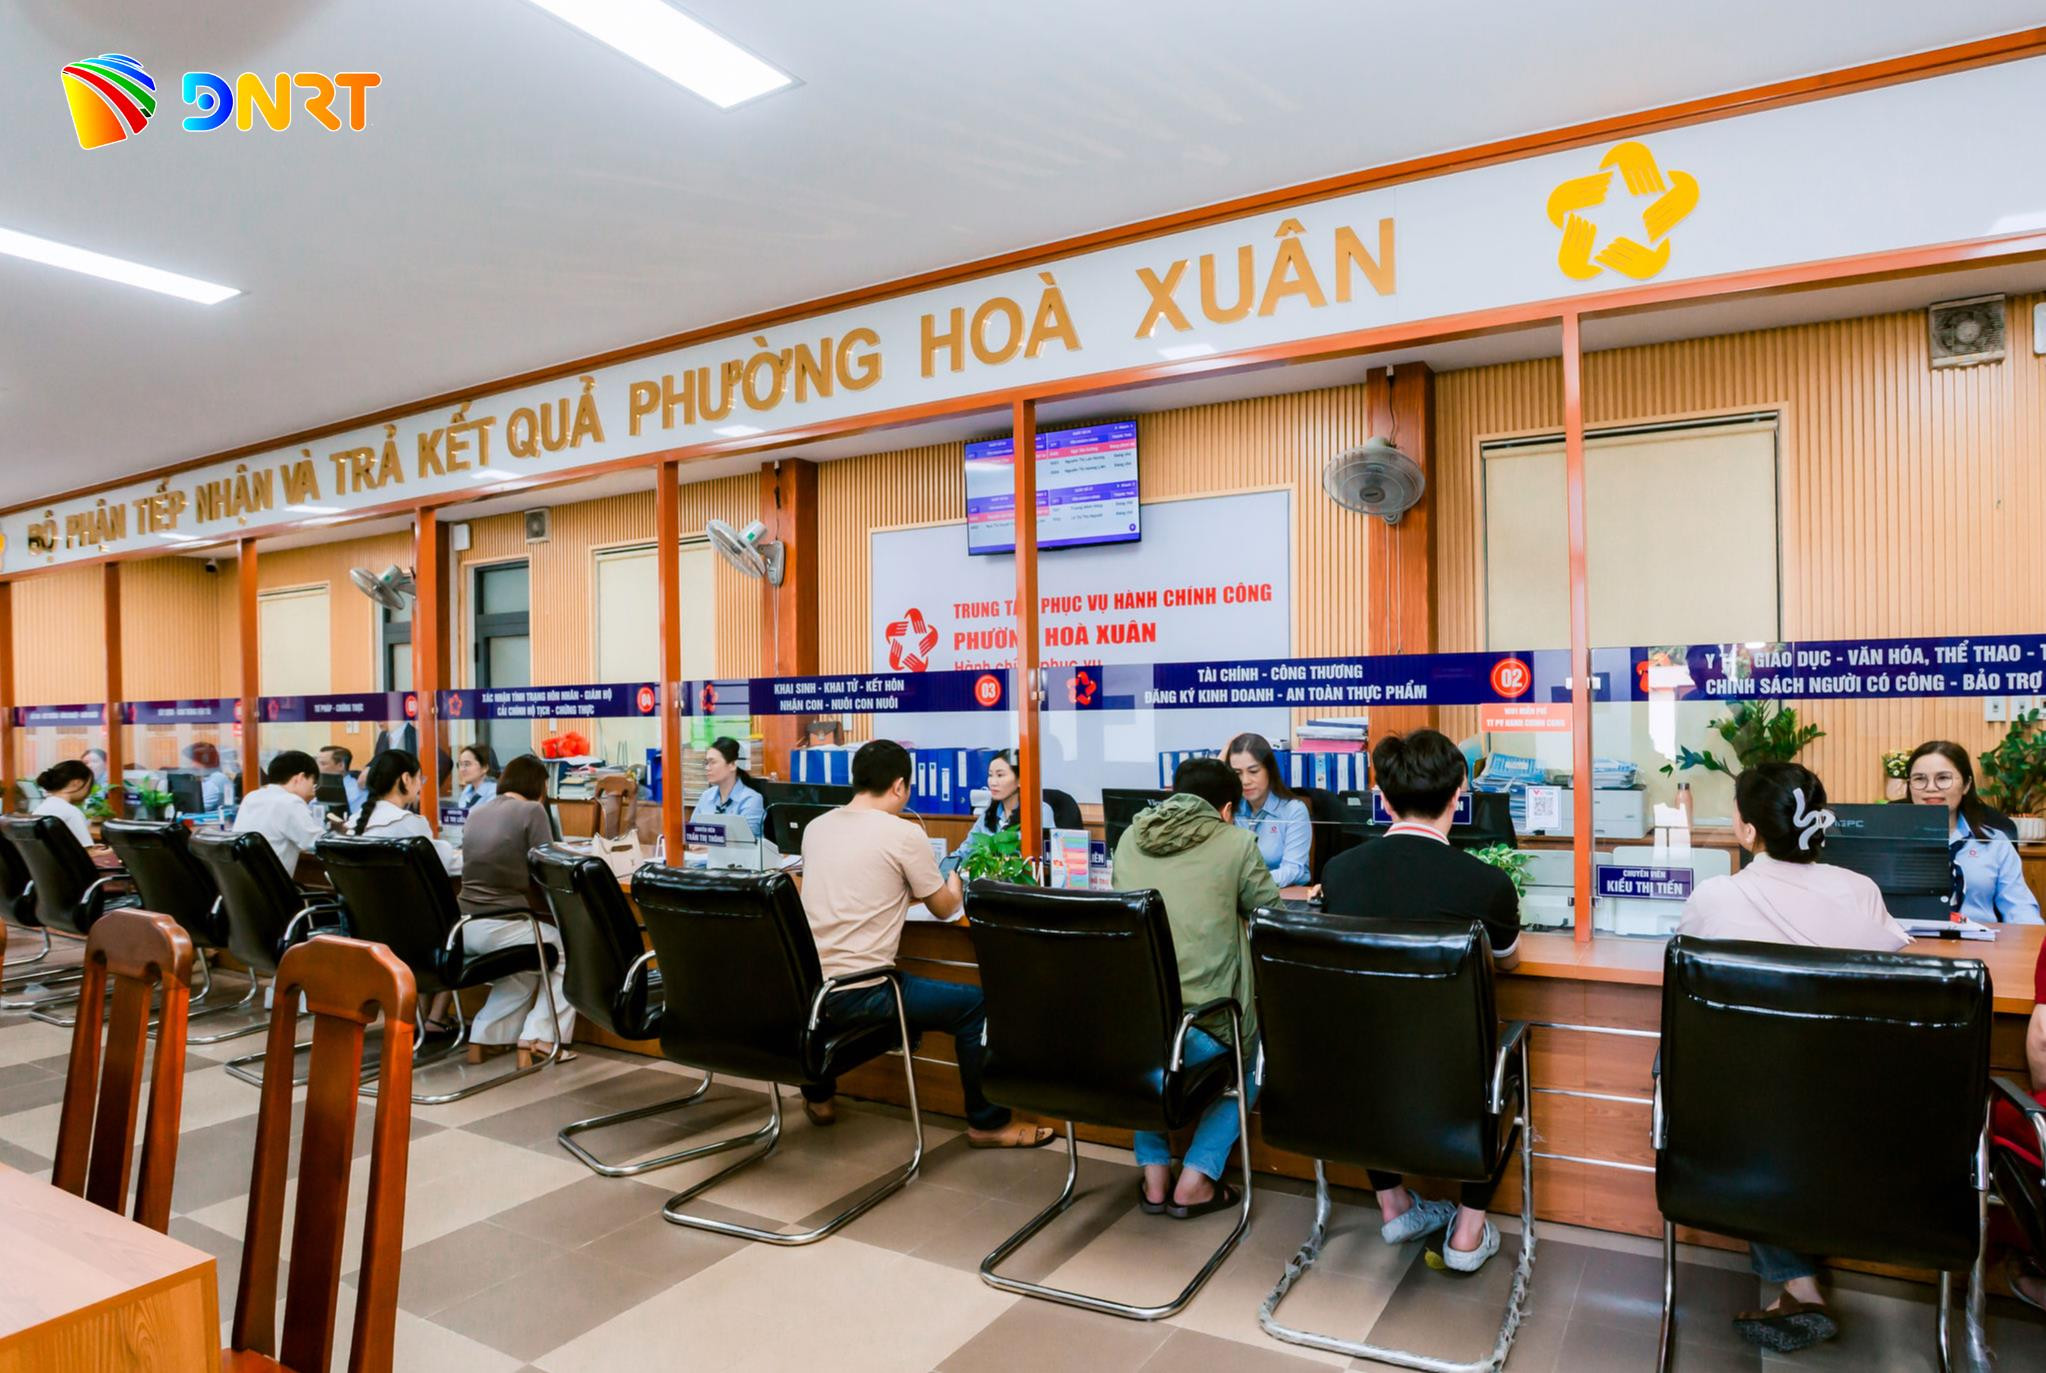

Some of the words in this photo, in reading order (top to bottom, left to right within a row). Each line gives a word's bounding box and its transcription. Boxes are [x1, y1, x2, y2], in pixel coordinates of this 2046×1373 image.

[66, 498, 126, 553] PHẬN
[195, 464, 273, 525] NHẬN
[280, 449, 321, 505] VÀ
[329, 424, 405, 496] TRẢ
[417, 400, 497, 479] KẾT
[506, 375, 606, 459] QUẢ
[629, 327, 883, 437] PHƯỜNG
[920, 271, 1084, 379] HOÀ
[1134, 217, 1398, 340] XUÂN
[954, 601, 1000, 619] TRUNG
[1041, 596, 1082, 616] PHỤC
[1088, 594, 1108, 614] VỤ
[1113, 590, 1157, 610] HÀNH
[1164, 585, 1217, 607] CHÍNH
[1223, 583, 1273, 604] CÔNG
[1045, 622, 1089, 647] HOÀ
[1096, 619, 1157, 645] XUÂN
[1705, 653, 1715, 669] Y
[1797, 650, 1831, 670] DỤC
[1848, 646, 1883, 666] VĂN
[1888, 645, 1930, 666] HÓA,
[1934, 640, 1969, 663] THỂ
[1973, 644, 2021, 662] THAO
[1198, 667, 1217, 683] TÀI
[1220, 666, 1259, 681] CHÍNH
[1271, 665, 1307, 680] CÔNG
[1310, 664, 1363, 680] THƯƠNG
[1500, 668, 1524, 689] 02
[1760, 675, 1804, 694] SÁCH
[1809, 673, 1861, 694] NGƯỜI
[1866, 672, 1890, 692] CÓ
[1895, 671, 1945, 692] CÔNG
[1963, 668, 2000, 690] BẢO
[2006, 670, 2043, 693] TRỢ
[774, 683, 793, 694] KHAI
[796, 682, 816, 694] SINH
[824, 682, 844, 693] KHAI
[982, 683, 996, 699] 03
[1179, 687, 1195, 703] KÝ
[1198, 688, 1228, 703] KINH
[1231, 688, 1274, 702] DOANH
[1286, 687, 1305, 701] AN
[1308, 685, 1343, 701] TOÀN
[1347, 685, 1382, 704] THỰC
[1385, 680, 1428, 700] PHẨM
[805, 700, 823, 711] CON
[854, 698, 873, 709] CON
[1635, 881, 1654, 895] THỊ
